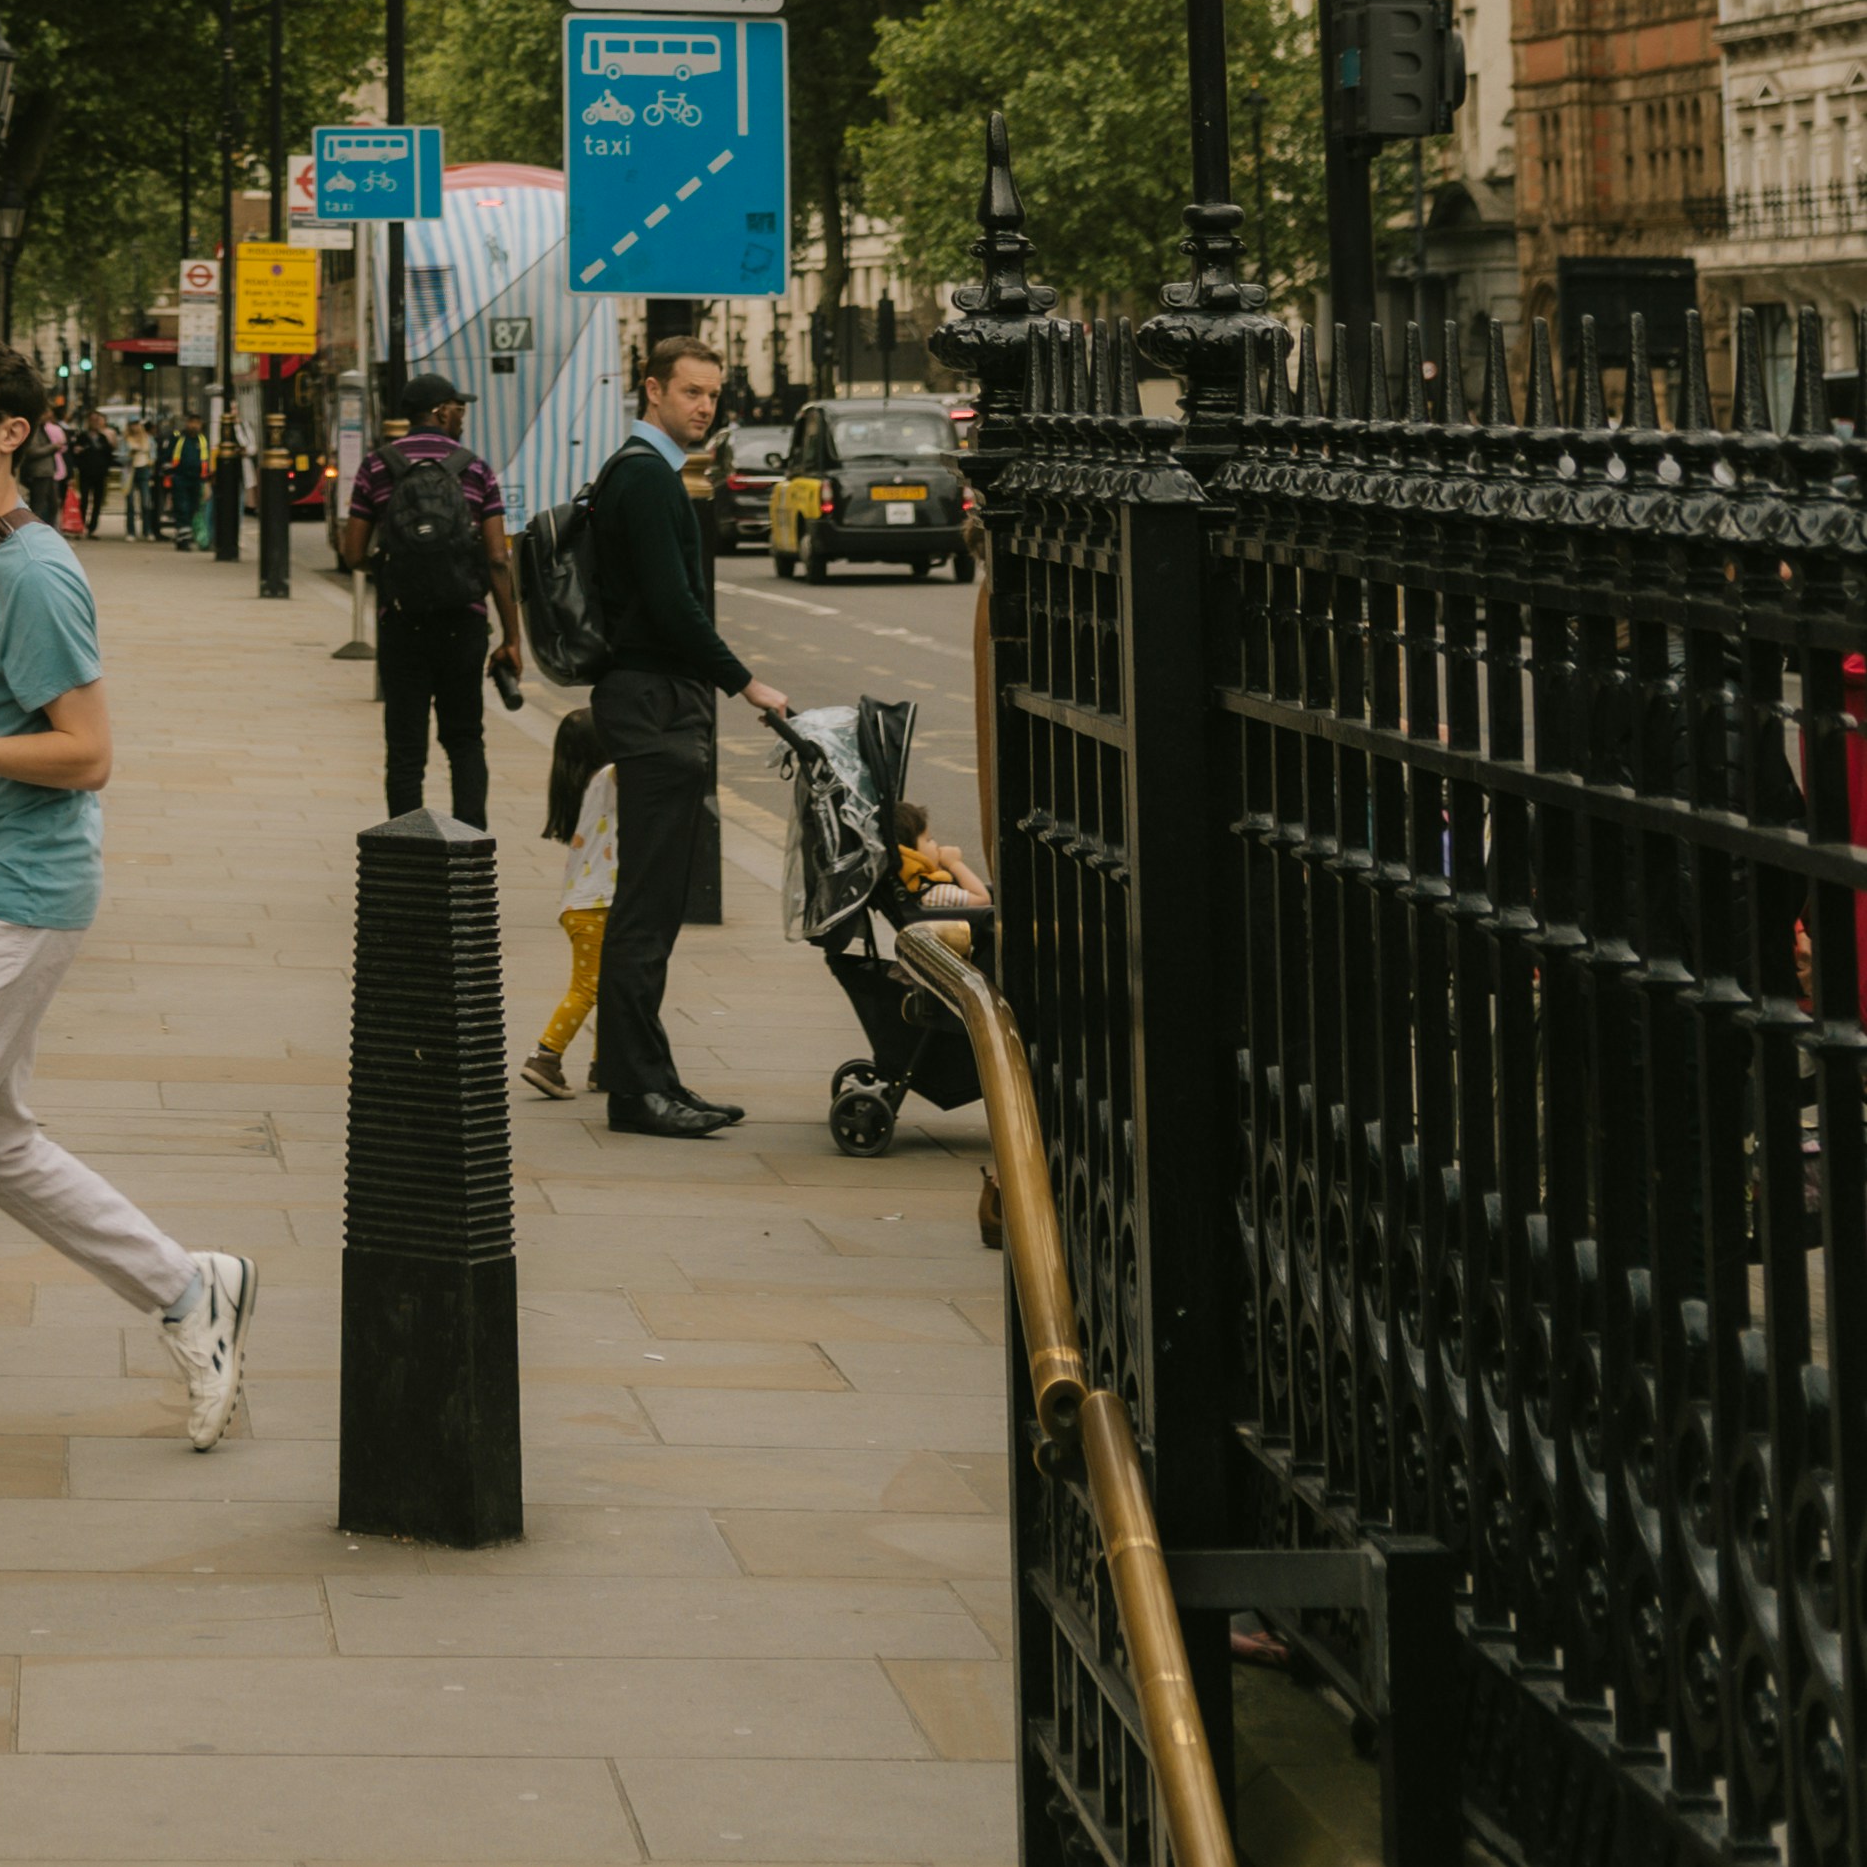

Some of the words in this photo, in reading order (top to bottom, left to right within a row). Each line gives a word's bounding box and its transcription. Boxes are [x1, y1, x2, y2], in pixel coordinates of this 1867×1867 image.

[583, 134, 631, 156] taxi
[324, 200, 354, 212] taxi
[494, 320, 530, 350] 87
